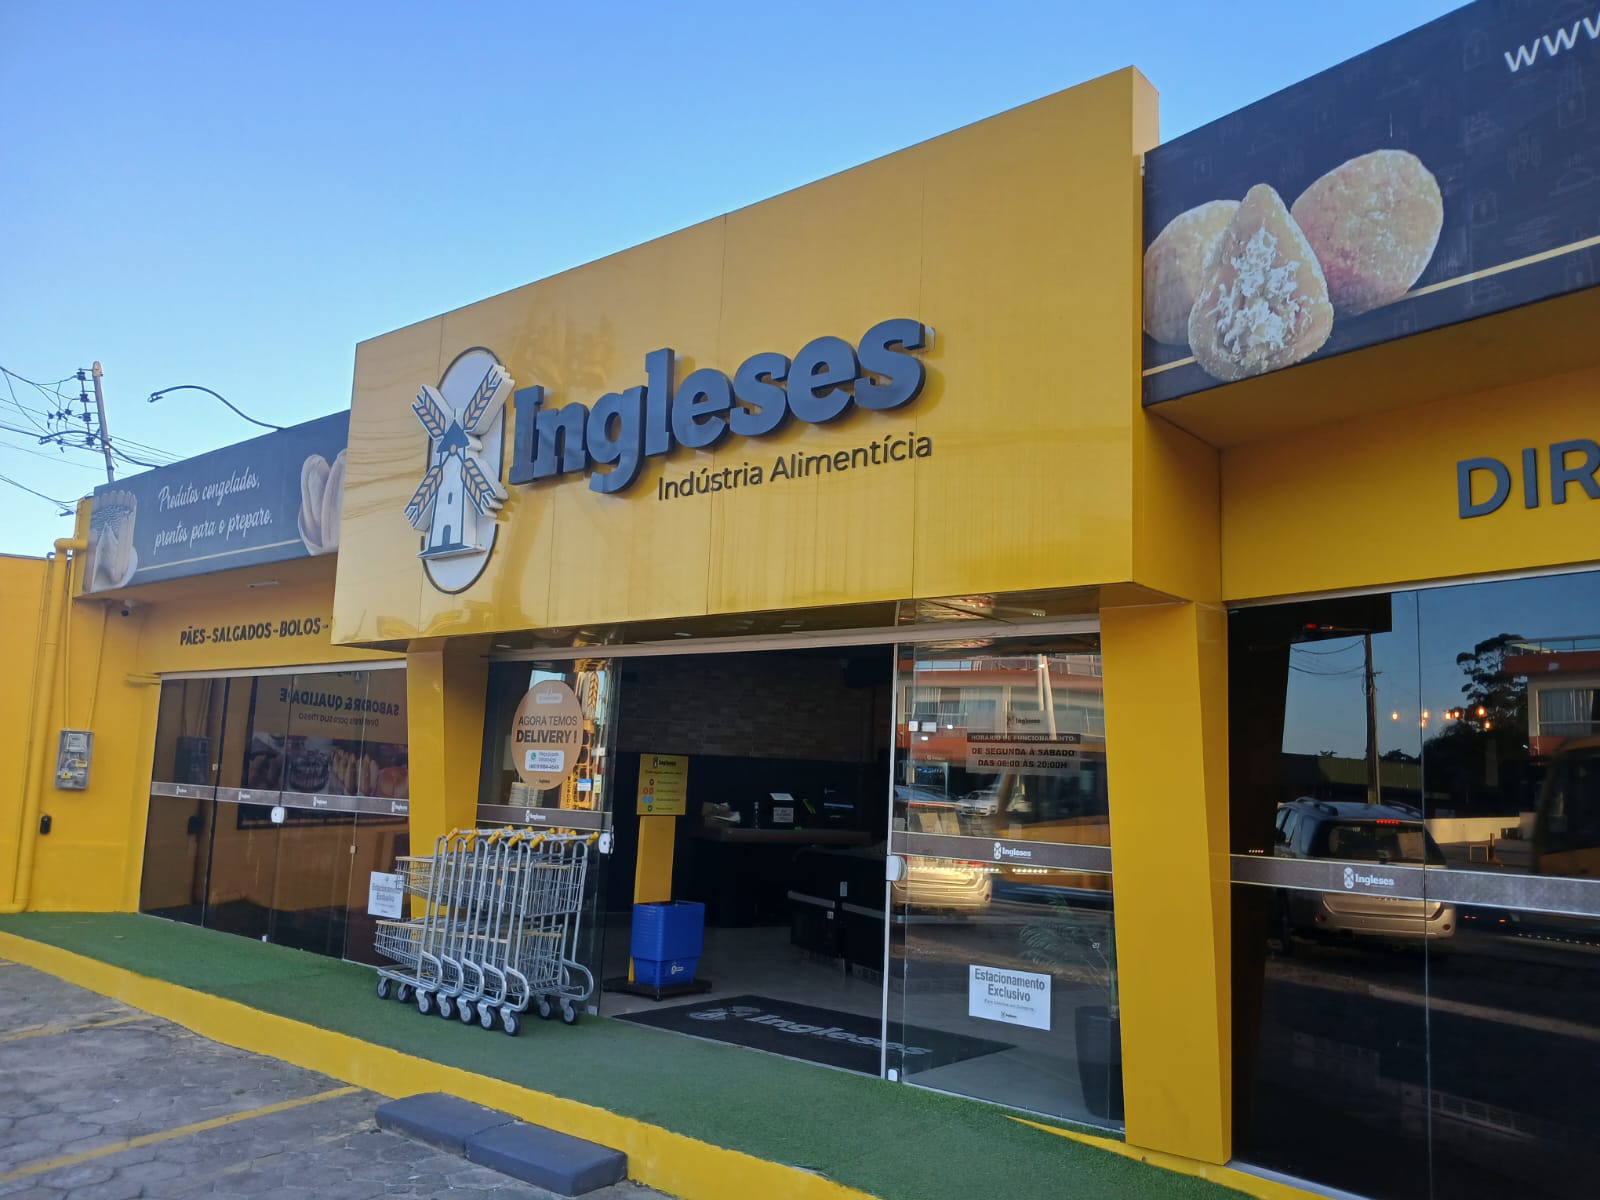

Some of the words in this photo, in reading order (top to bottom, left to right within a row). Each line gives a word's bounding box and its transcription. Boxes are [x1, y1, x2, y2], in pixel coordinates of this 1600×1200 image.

[508, 318, 927, 494] Ingleses
[658, 461, 764, 501] Indústria
[770, 432, 932, 482] Alimentícia
[158, 482, 200, 512] Produtos
[153, 521, 189, 556] prontos
[190, 520, 216, 549] para
[218, 519, 225, 534] o
[226, 507, 273, 541] preparo.
[518, 715, 547, 726] AGORA
[548, 715, 578, 726] TEMOS
[971, 747, 983, 755] DE
[984, 747, 1026, 756] SEGUNDA
[978, 759, 994, 767] DAS
[1002, 847, 1032, 857] Ingleses
[1355, 873, 1395, 886] Ingleses
[975, 968, 1045, 991] Estacionamento
[988, 984, 1031, 1002] Exclusivo
